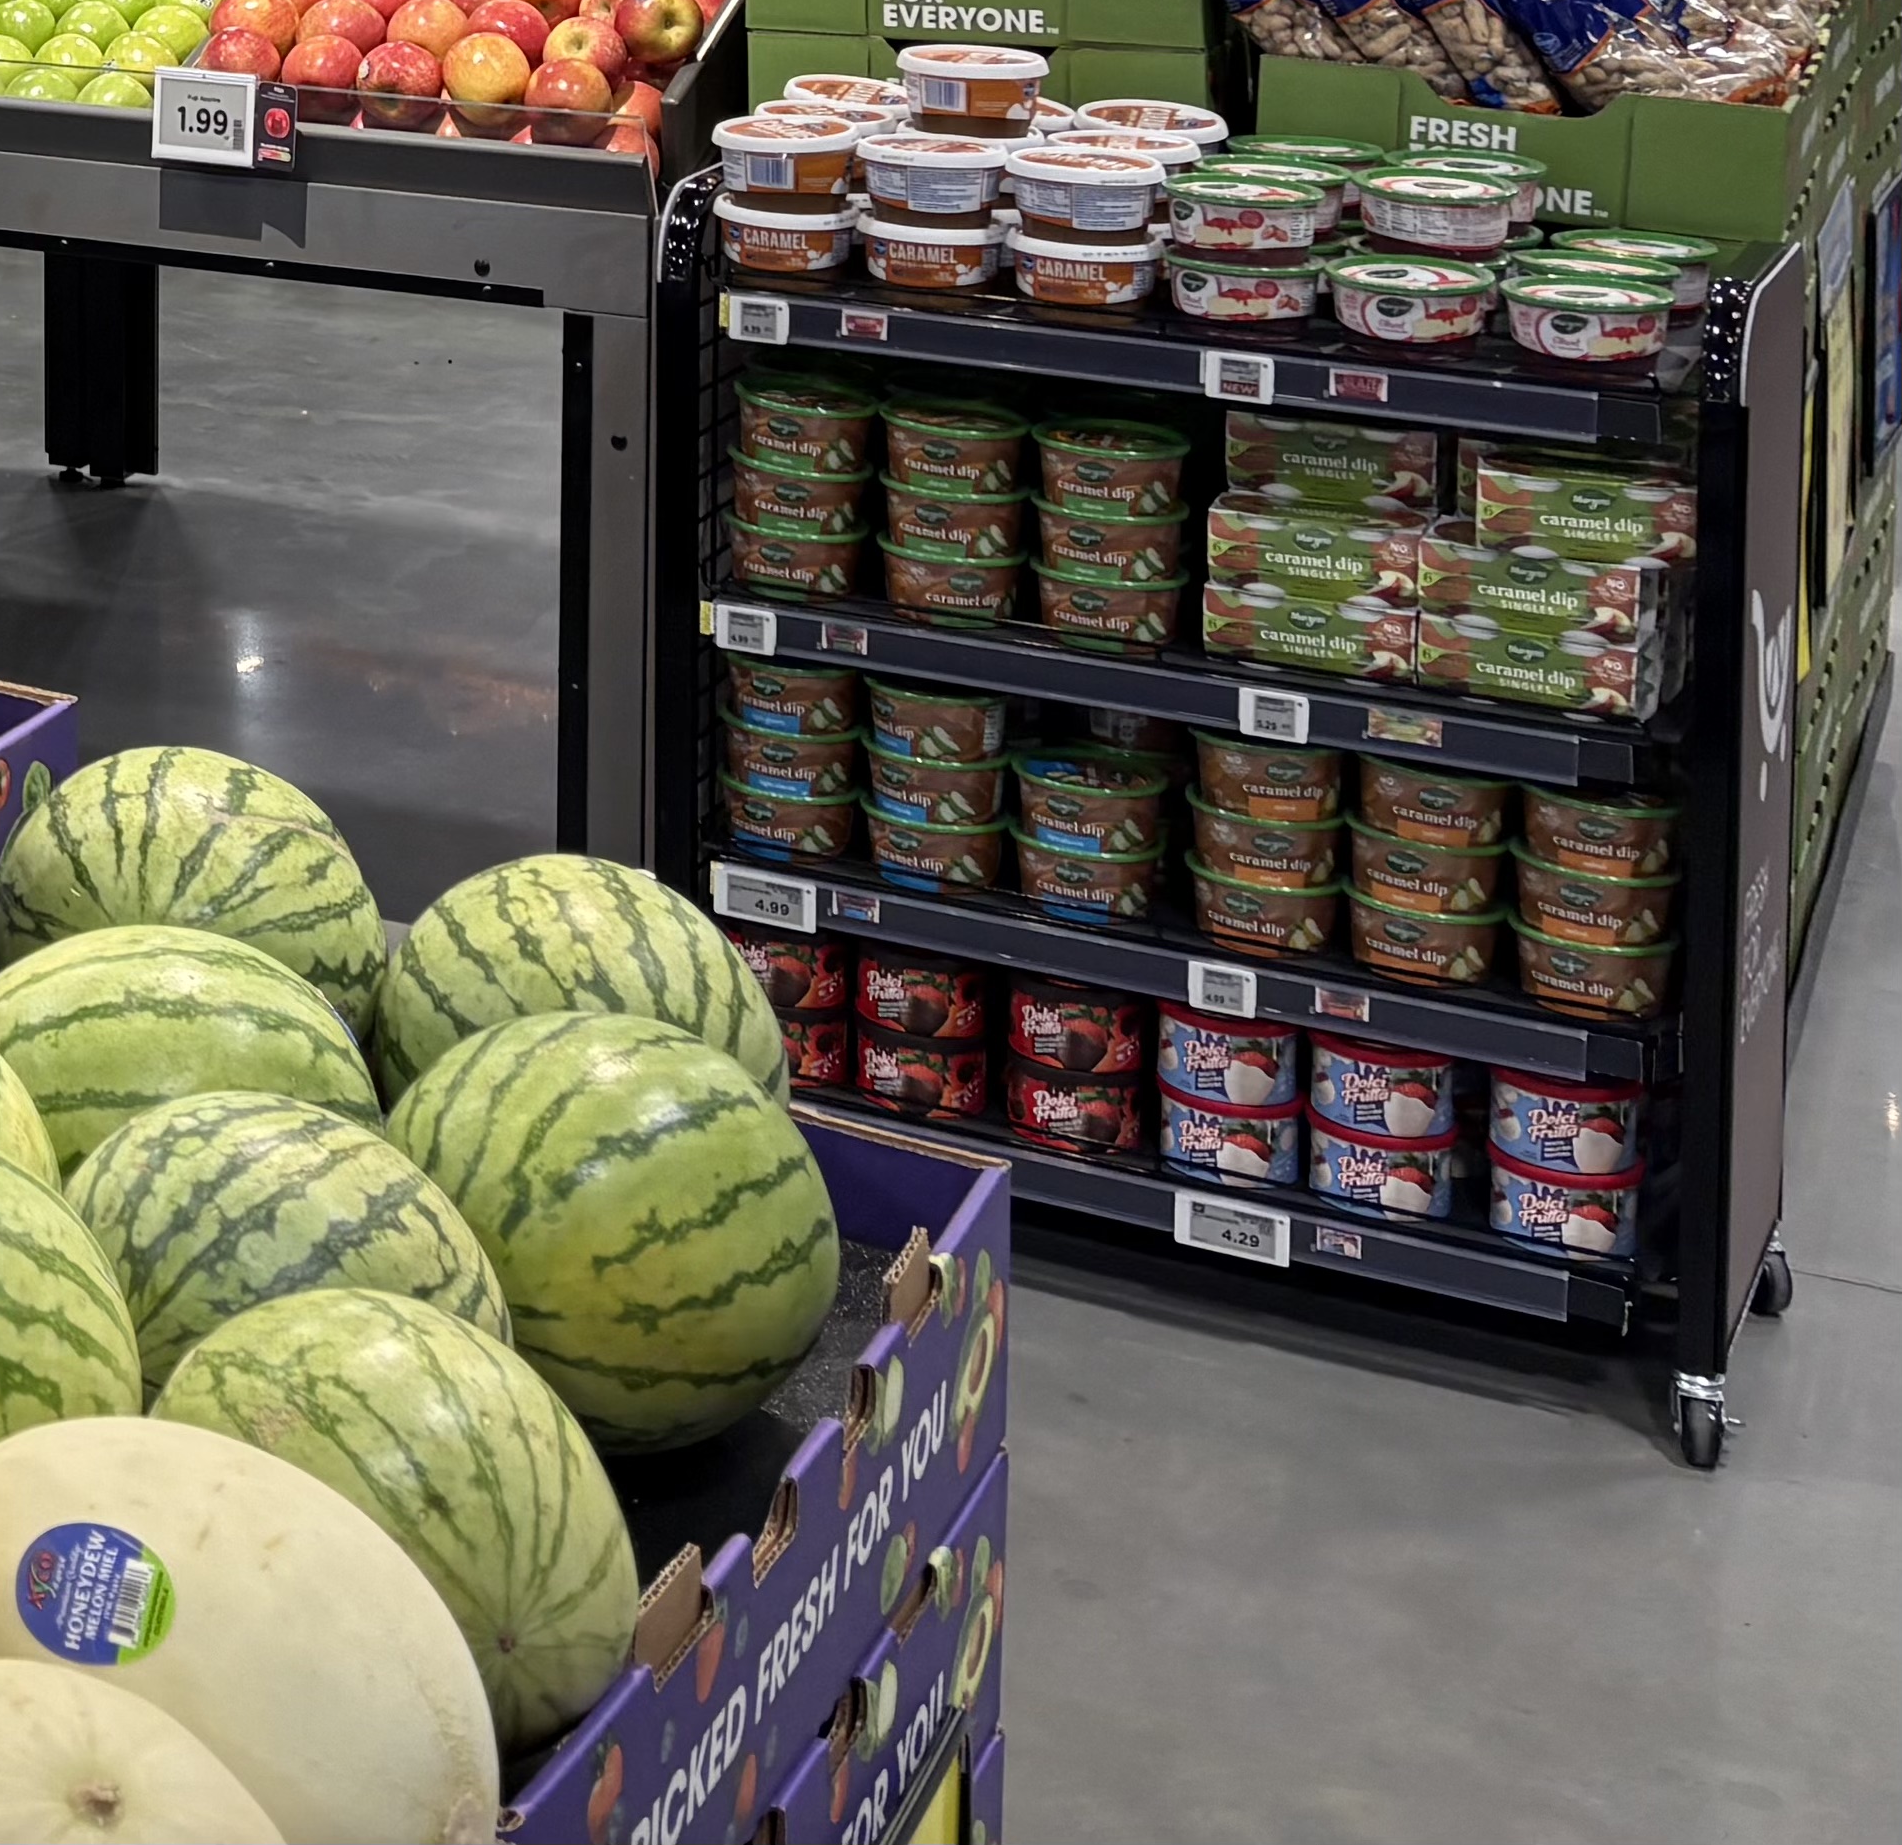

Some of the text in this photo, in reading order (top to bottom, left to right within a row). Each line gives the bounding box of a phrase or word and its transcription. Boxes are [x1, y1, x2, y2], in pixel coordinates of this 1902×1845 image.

[881, 3, 1046, 33] EVERYONE
[177, 105, 228, 136] 1.99
[1409, 115, 1517, 151] FRESH
[743, 227, 809, 251] CARAMEL
[889, 241, 957, 265] CARAMEL
[1036, 259, 1107, 282] CARAMEL
[904, 456, 980, 481] caramel dip
[1540, 513, 1644, 537] caramel dip
[1564, 529, 1620, 543] SINGLES
[1265, 550, 1363, 574] caramel dip
[1286, 566, 1341, 581] SINGLES
[1476, 661, 1576, 689] caramel dip
[1499, 678, 1553, 695] SINGLES
[1243, 782, 1323, 800] caramel dip
[755, 898, 790, 917] 4.99
[1538, 900, 1623, 930] caramel dip
[1183, 1039, 1229, 1058] Dolci
[1340, 1072, 1388, 1091] Dolci
[1032, 1090, 1077, 1109] Dolci
[1528, 1109, 1577, 1127] Dolci
[1519, 1192, 1569, 1212] Dolci
[1221, 1228, 1261, 1248] 4.29
[63, 1528, 108, 1652] HONEYDEW
[84, 1545, 120, 1642] MELON MIEL
[629, 1380, 949, 1845] PICKED FRESH FOR YOU
